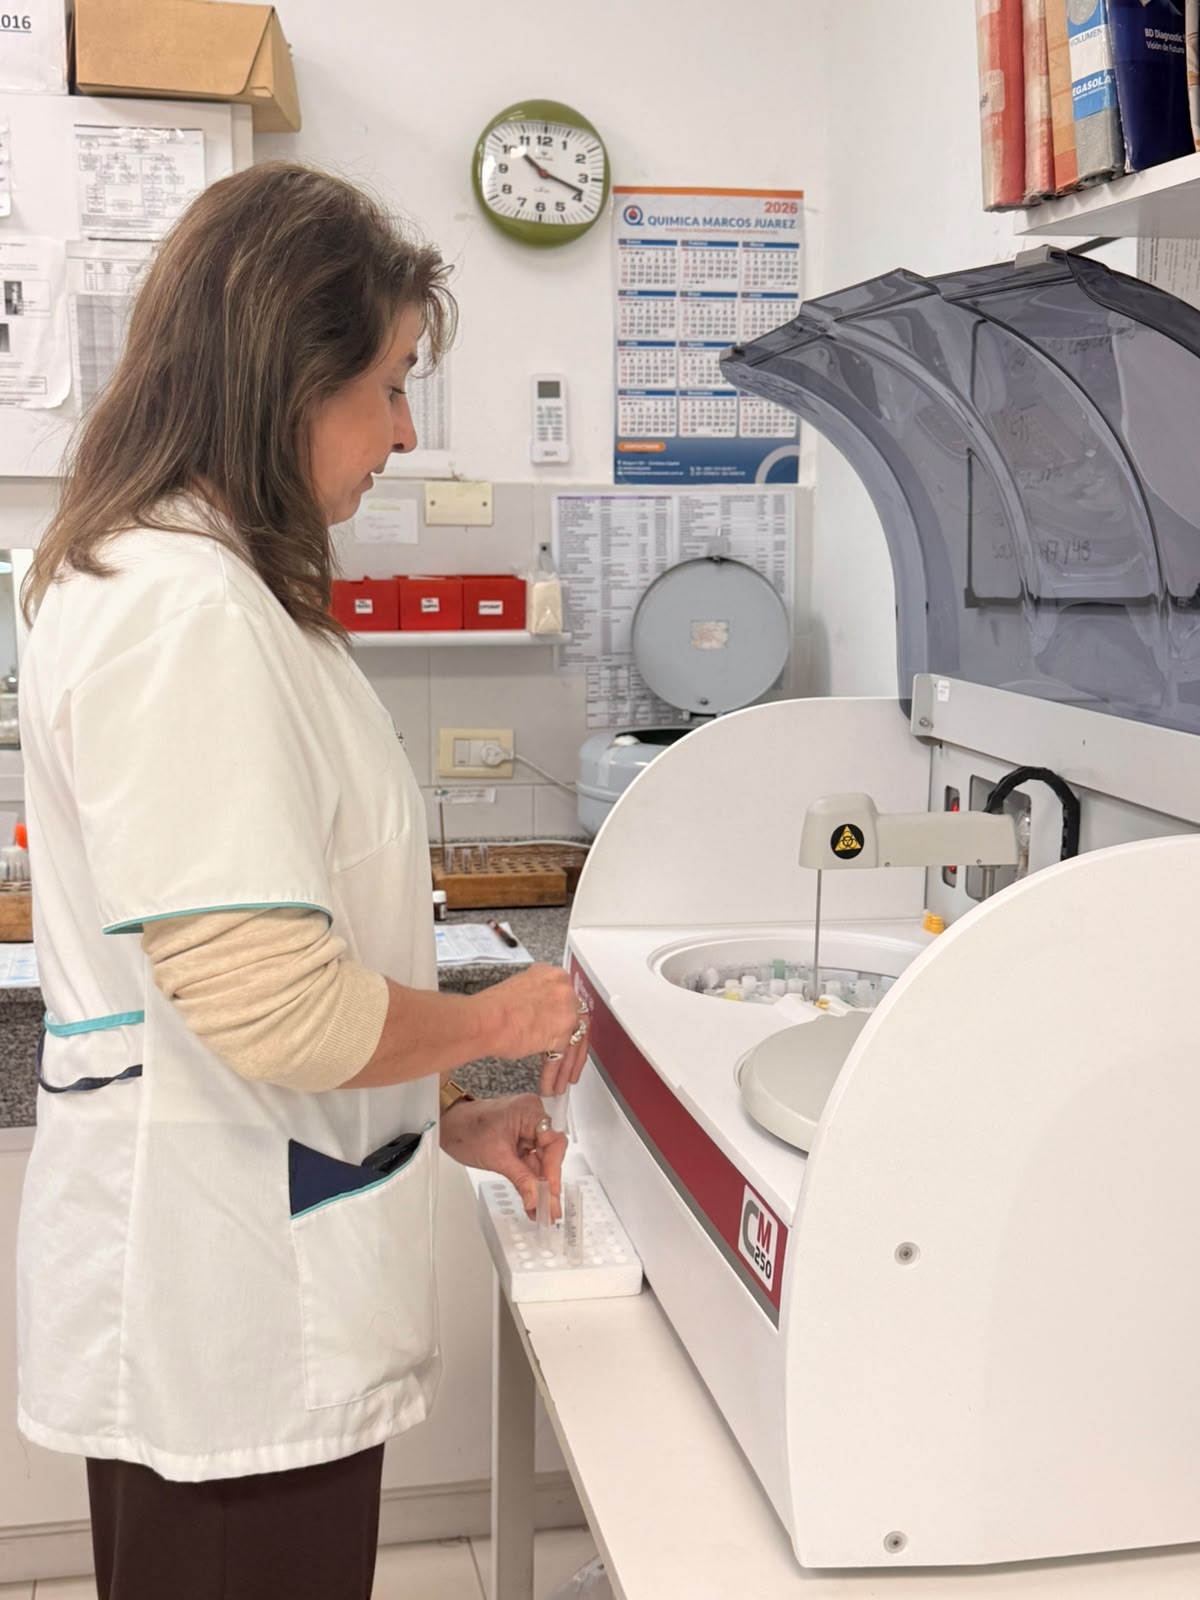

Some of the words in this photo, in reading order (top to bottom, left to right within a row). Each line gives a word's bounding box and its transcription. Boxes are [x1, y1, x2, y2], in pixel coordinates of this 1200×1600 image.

[0, 14, 31, 29] 016
[1071, 28, 1102, 46] VOLUMEN
[520, 136, 530, 146] 11
[536, 136, 553, 146] 12
[562, 141, 567, 150] 1
[575, 153, 586, 164] 2
[498, 163, 508, 173] 9
[578, 174, 588, 184] 3
[502, 184, 512, 194] 8
[517, 197, 527, 207] 7
[572, 192, 583, 202] 4
[536, 202, 546, 212] 6
[555, 202, 565, 212] 5
[764, 201, 797, 214] 2026
[648, 215, 699, 227] QUIMICA
[702, 217, 751, 228] MARCOS
[753, 218, 795, 229] JUAREZ
[754, 1245, 772, 1279] 250
